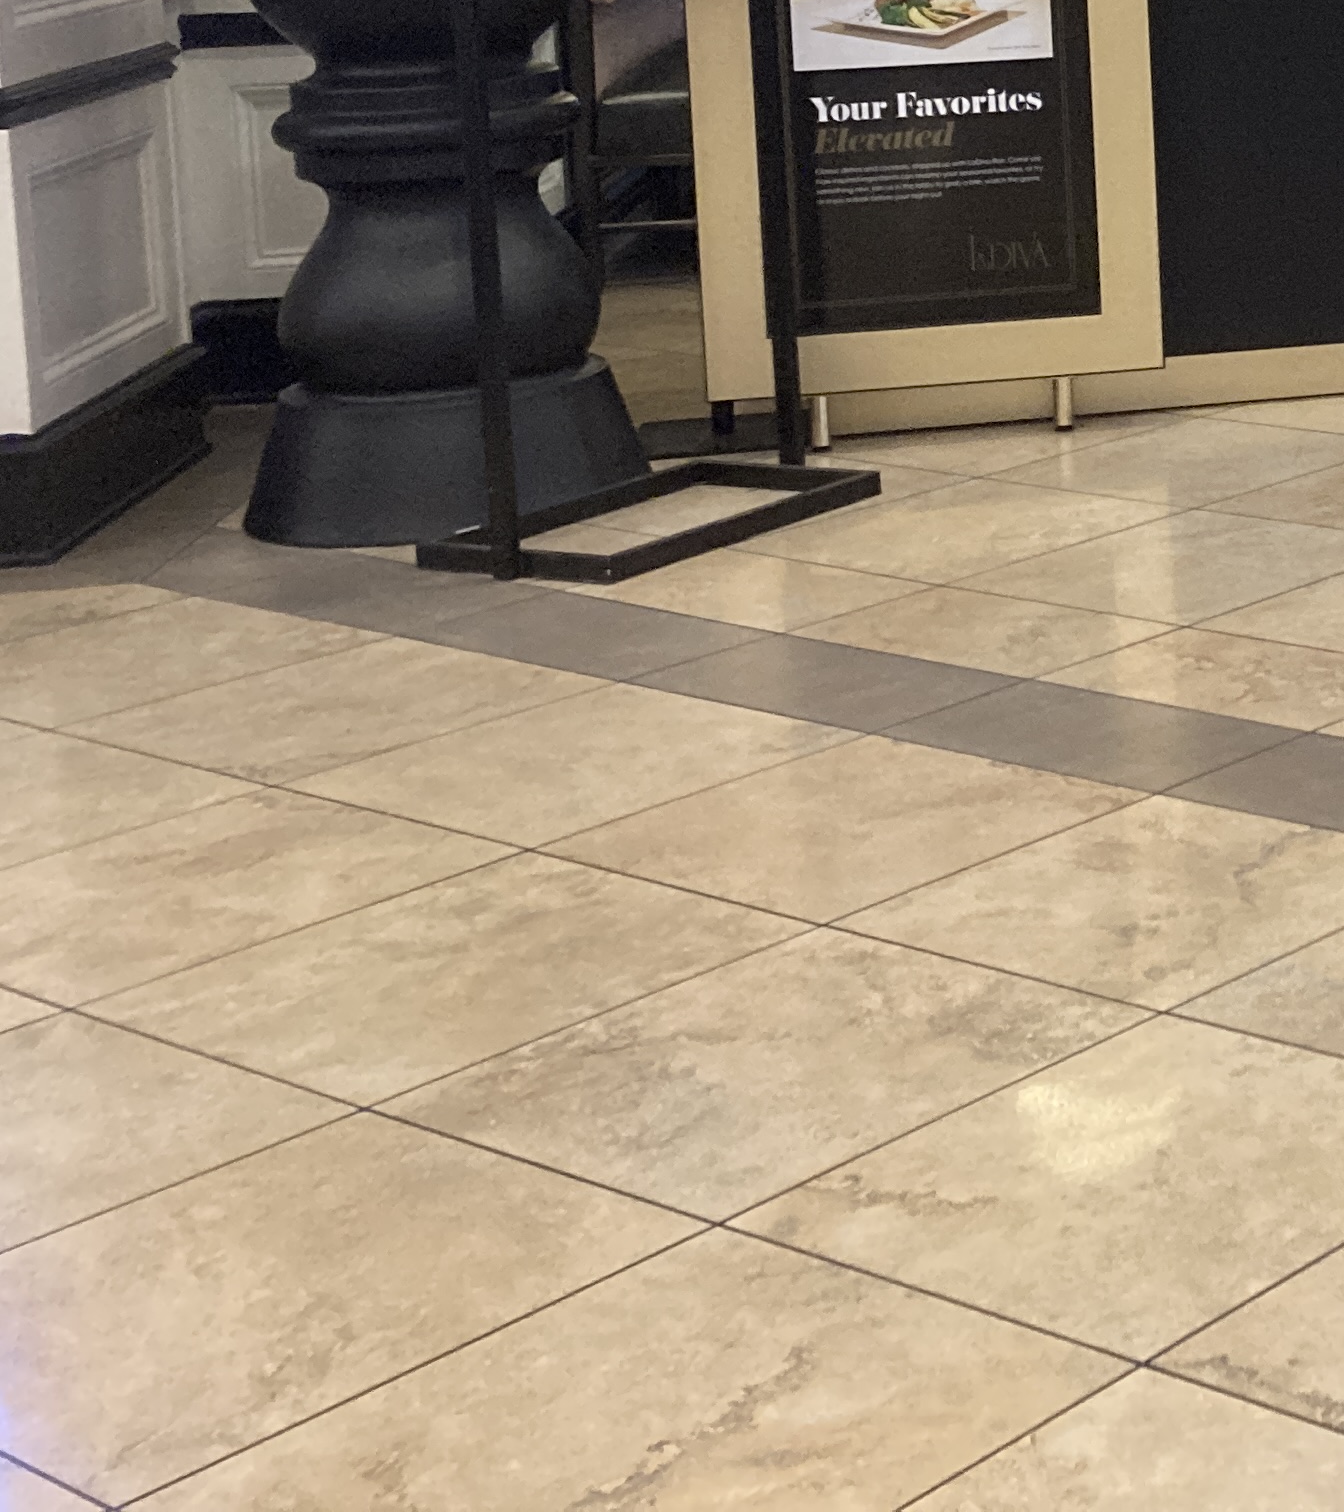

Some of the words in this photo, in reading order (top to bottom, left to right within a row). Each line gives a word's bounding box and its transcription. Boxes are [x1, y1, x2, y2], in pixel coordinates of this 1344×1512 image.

[809, 96, 887, 122] Your
[896, 87, 1043, 119] Favorites
[815, 120, 955, 154] Elevated
